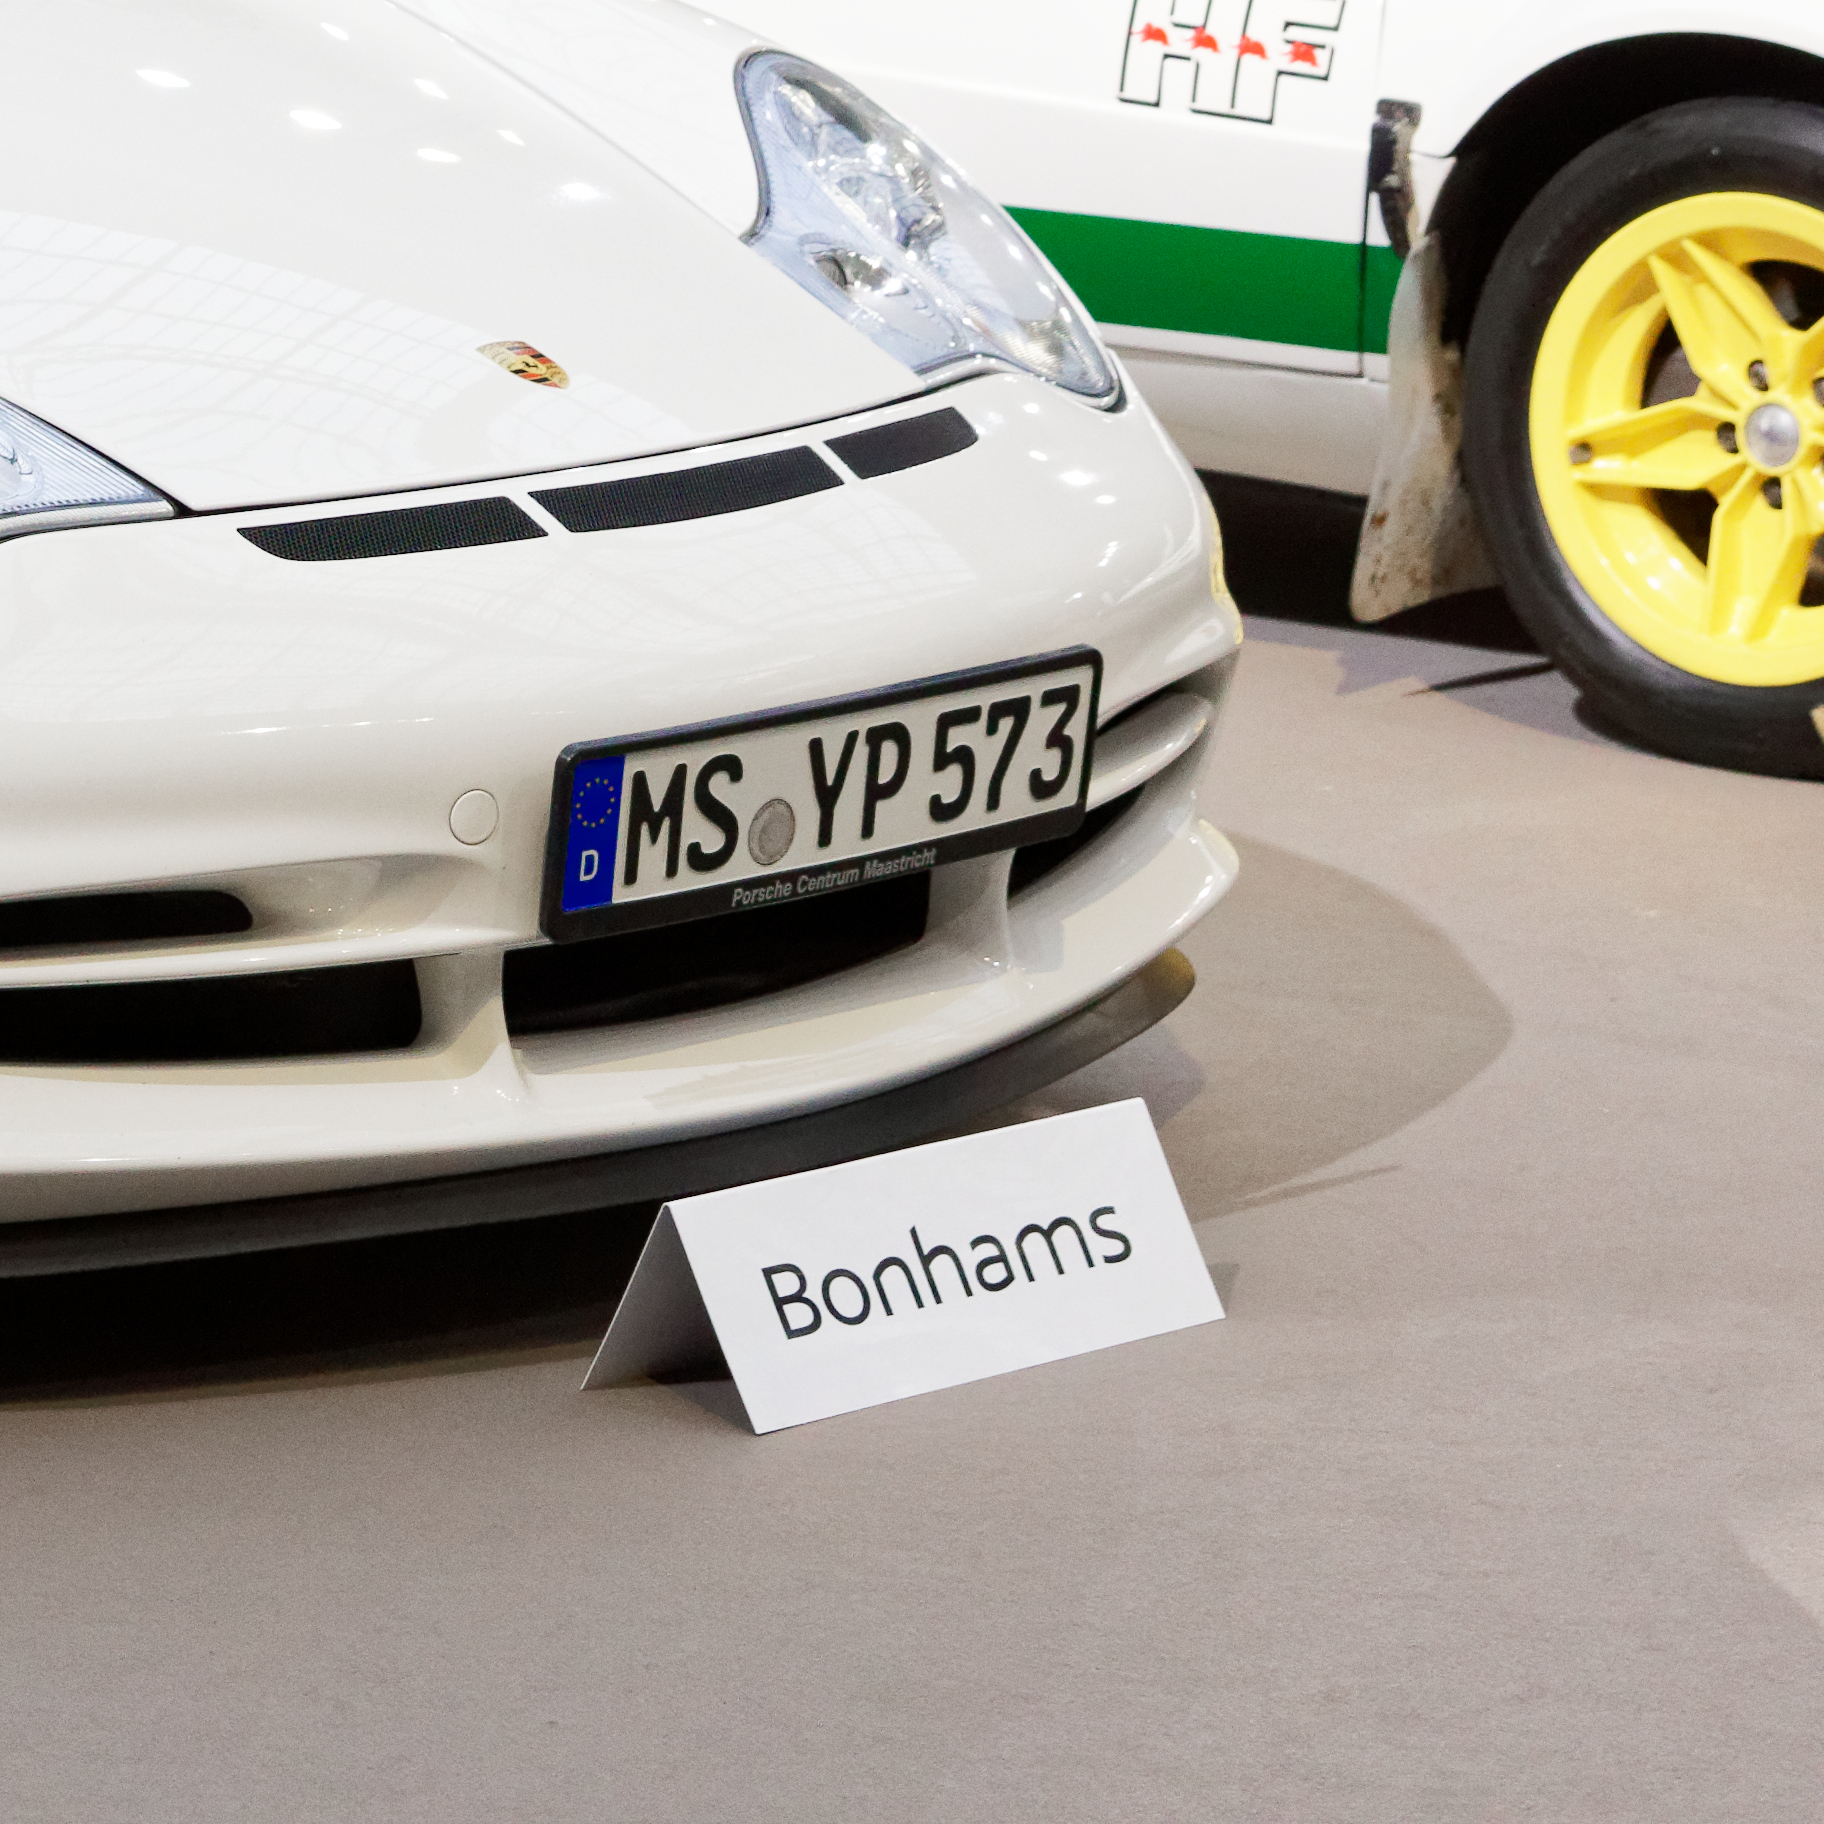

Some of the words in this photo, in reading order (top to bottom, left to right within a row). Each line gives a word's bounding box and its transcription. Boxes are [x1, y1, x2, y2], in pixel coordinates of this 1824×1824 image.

[623, 754, 743, 887] MS
[808, 721, 912, 849] YP
[929, 683, 1081, 824] 573
[579, 849, 599, 882] D
[731, 879, 793, 908] Porsche
[796, 867, 860, 894] Centrum
[862, 847, 937, 880] Maastricht
[760, 1206, 1132, 1340] Bonhams
